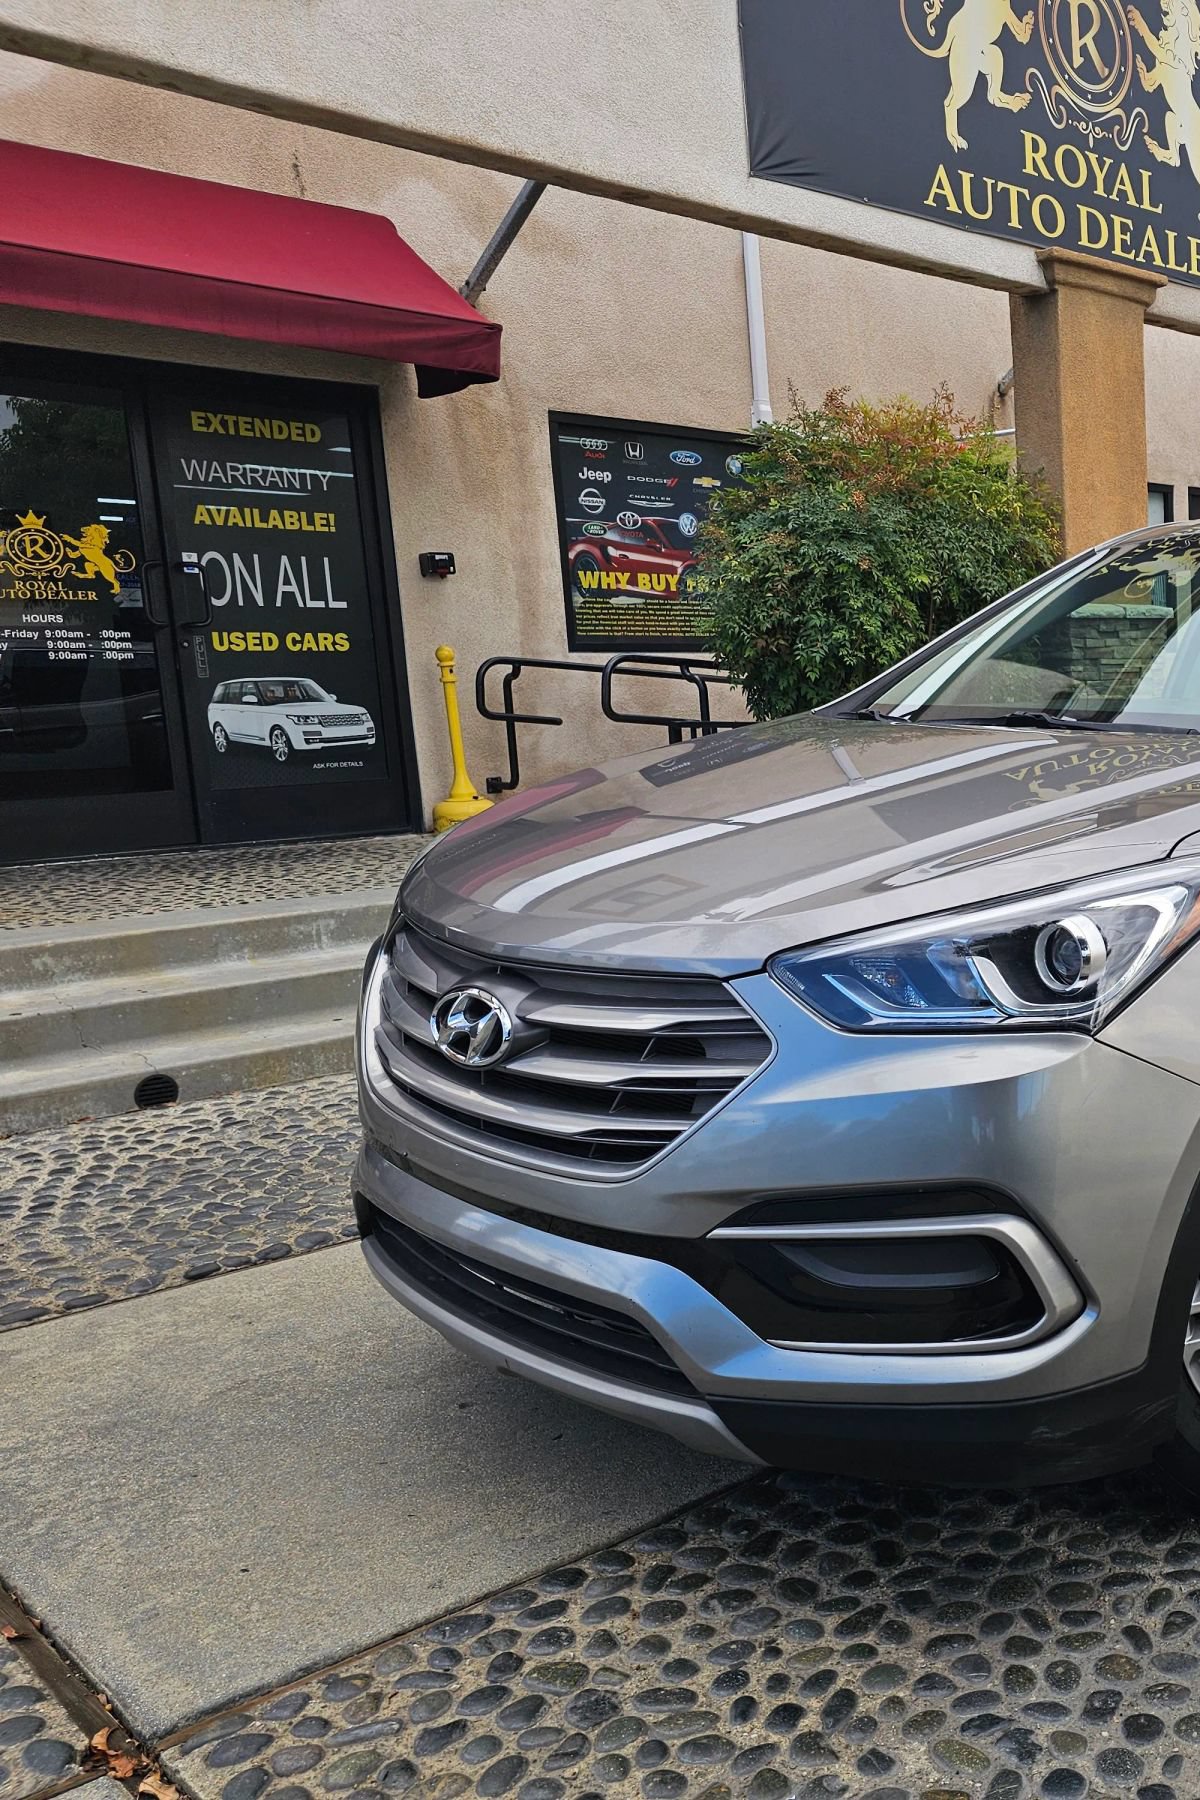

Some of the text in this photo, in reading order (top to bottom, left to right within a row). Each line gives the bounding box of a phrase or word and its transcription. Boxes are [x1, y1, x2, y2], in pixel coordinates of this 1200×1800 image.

[1020, 129, 1163, 214] ROYAL
[925, 164, 1066, 238] AUTO
[190, 410, 322, 443] EXTENDED
[676, 452, 696, 464] Ford
[180, 458, 332, 491] WARRANTY
[578, 466, 612, 483] Jeep
[626, 475, 669, 484] DODGE
[193, 504, 336, 532] AVAILABLE!
[15, 580, 67, 591] ROYAL
[199, 550, 348, 609] ON ALL
[577, 570, 631, 590] WHY
[637, 573, 680, 592] BUY
[35, 590, 99, 601] DEALER
[22, 614, 64, 623] HOURS
[44, 629, 84, 638] 9:00am
[99, 630, 131, 640] :00pm
[211, 631, 350, 651] USED CARS
[46, 640, 86, 649] 9:00am
[101, 641, 132, 651] :00pm
[195, 637, 206, 668] PULL
[48, 651, 88, 660] 9:00am
[102, 652, 134, 662] :00pm
[340, 760, 364, 768] DETAILS
